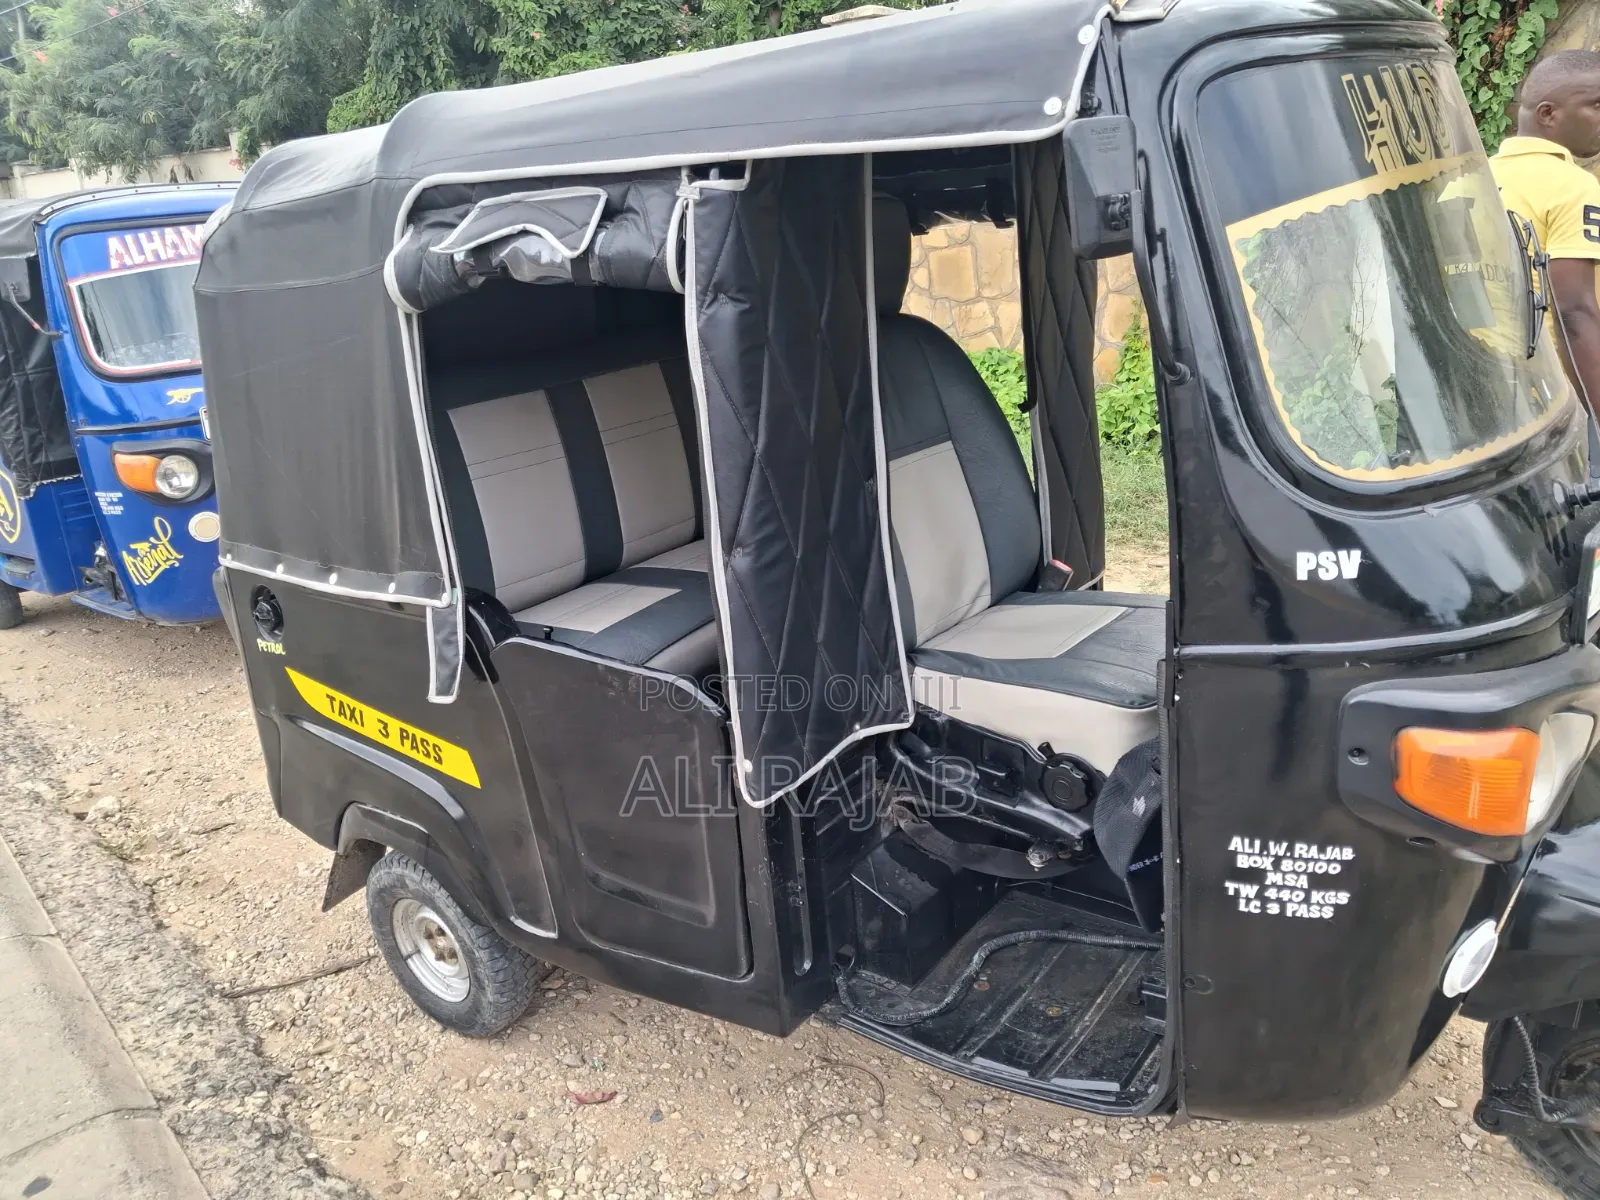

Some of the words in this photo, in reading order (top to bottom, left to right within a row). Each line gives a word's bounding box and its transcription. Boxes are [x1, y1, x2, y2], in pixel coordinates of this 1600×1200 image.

[1296, 549, 1362, 581] PSV
[256, 638, 286, 656] PETROL
[325, 693, 365, 728] TAXI
[376, 717, 391, 740] 3
[399, 726, 443, 766] PASS
[1236, 854, 1275, 871] BOX
[1280, 859, 1342, 875] 80100
[1264, 871, 1309, 889] MSA
[1224, 881, 1260, 899] TW
[1264, 887, 1305, 903] 440
[1310, 890, 1351, 905] KGS
[1238, 898, 1261, 913] LC
[1266, 902, 1280, 915] 3
[1286, 902, 1335, 919] PASS
